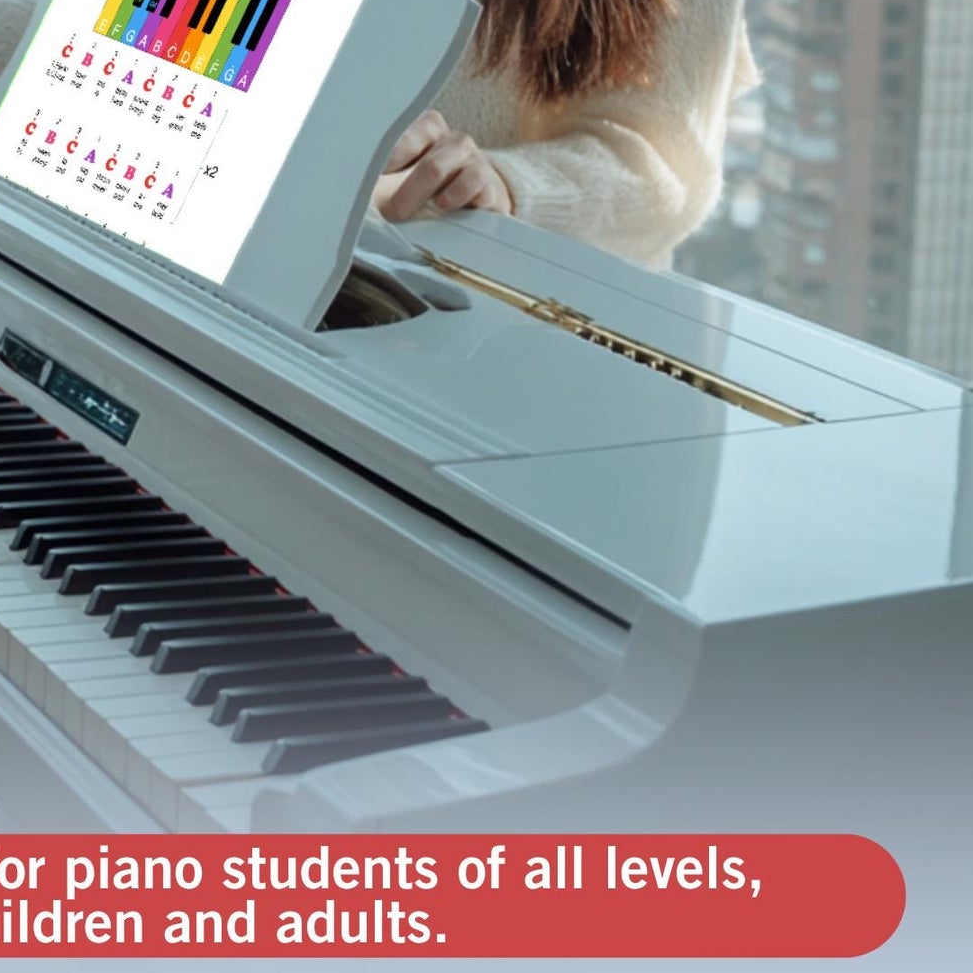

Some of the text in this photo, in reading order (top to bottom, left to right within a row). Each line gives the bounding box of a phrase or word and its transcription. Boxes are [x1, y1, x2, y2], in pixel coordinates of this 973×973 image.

[81, 52, 94, 67] B
[121, 70, 134, 85] A
[161, 85, 175, 101] B
[200, 102, 213, 117] A
[44, 130, 57, 145] B
[84, 149, 96, 164] A
[123, 165, 136, 181] B
[161, 183, 174, 199] A
[203, 164, 219, 179] x2
